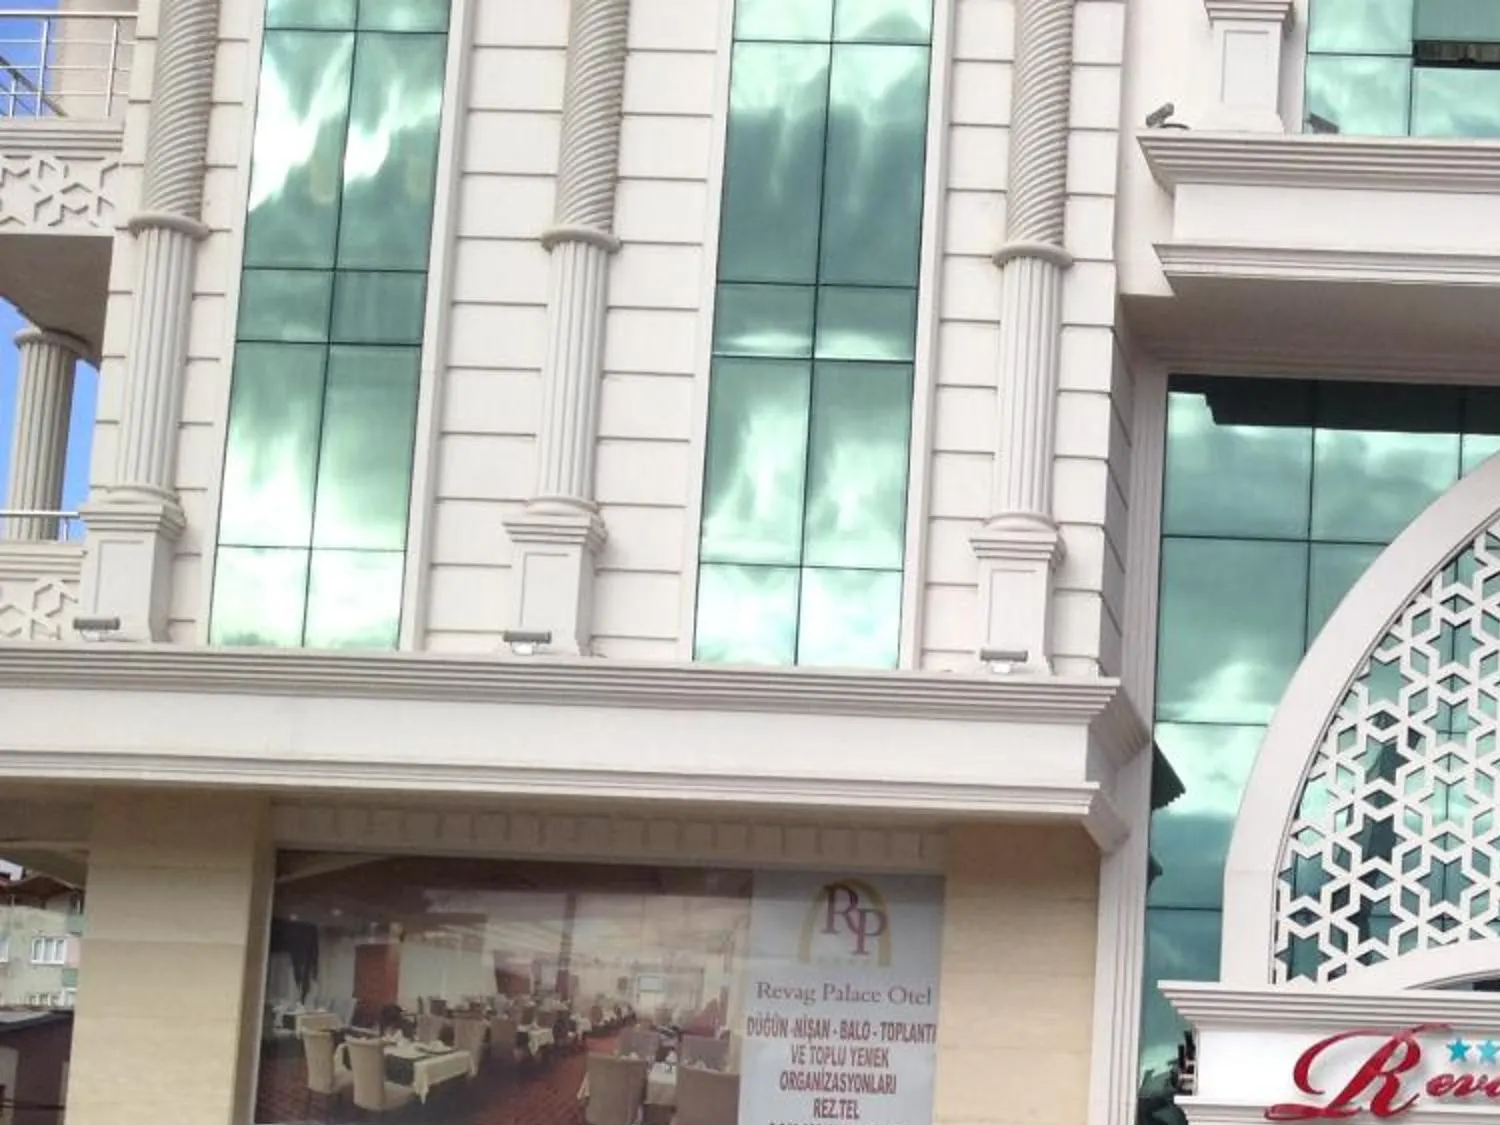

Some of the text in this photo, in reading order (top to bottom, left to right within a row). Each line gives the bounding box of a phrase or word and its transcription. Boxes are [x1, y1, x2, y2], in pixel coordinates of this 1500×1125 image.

[822, 983, 882, 1004] Palace
[887, 986, 932, 1006] Otel
[839, 1020, 871, 1041] BALO
[880, 1021, 937, 1044] TOPLANTI
[791, 1044, 889, 1068] VE TOPLU YEMEK
